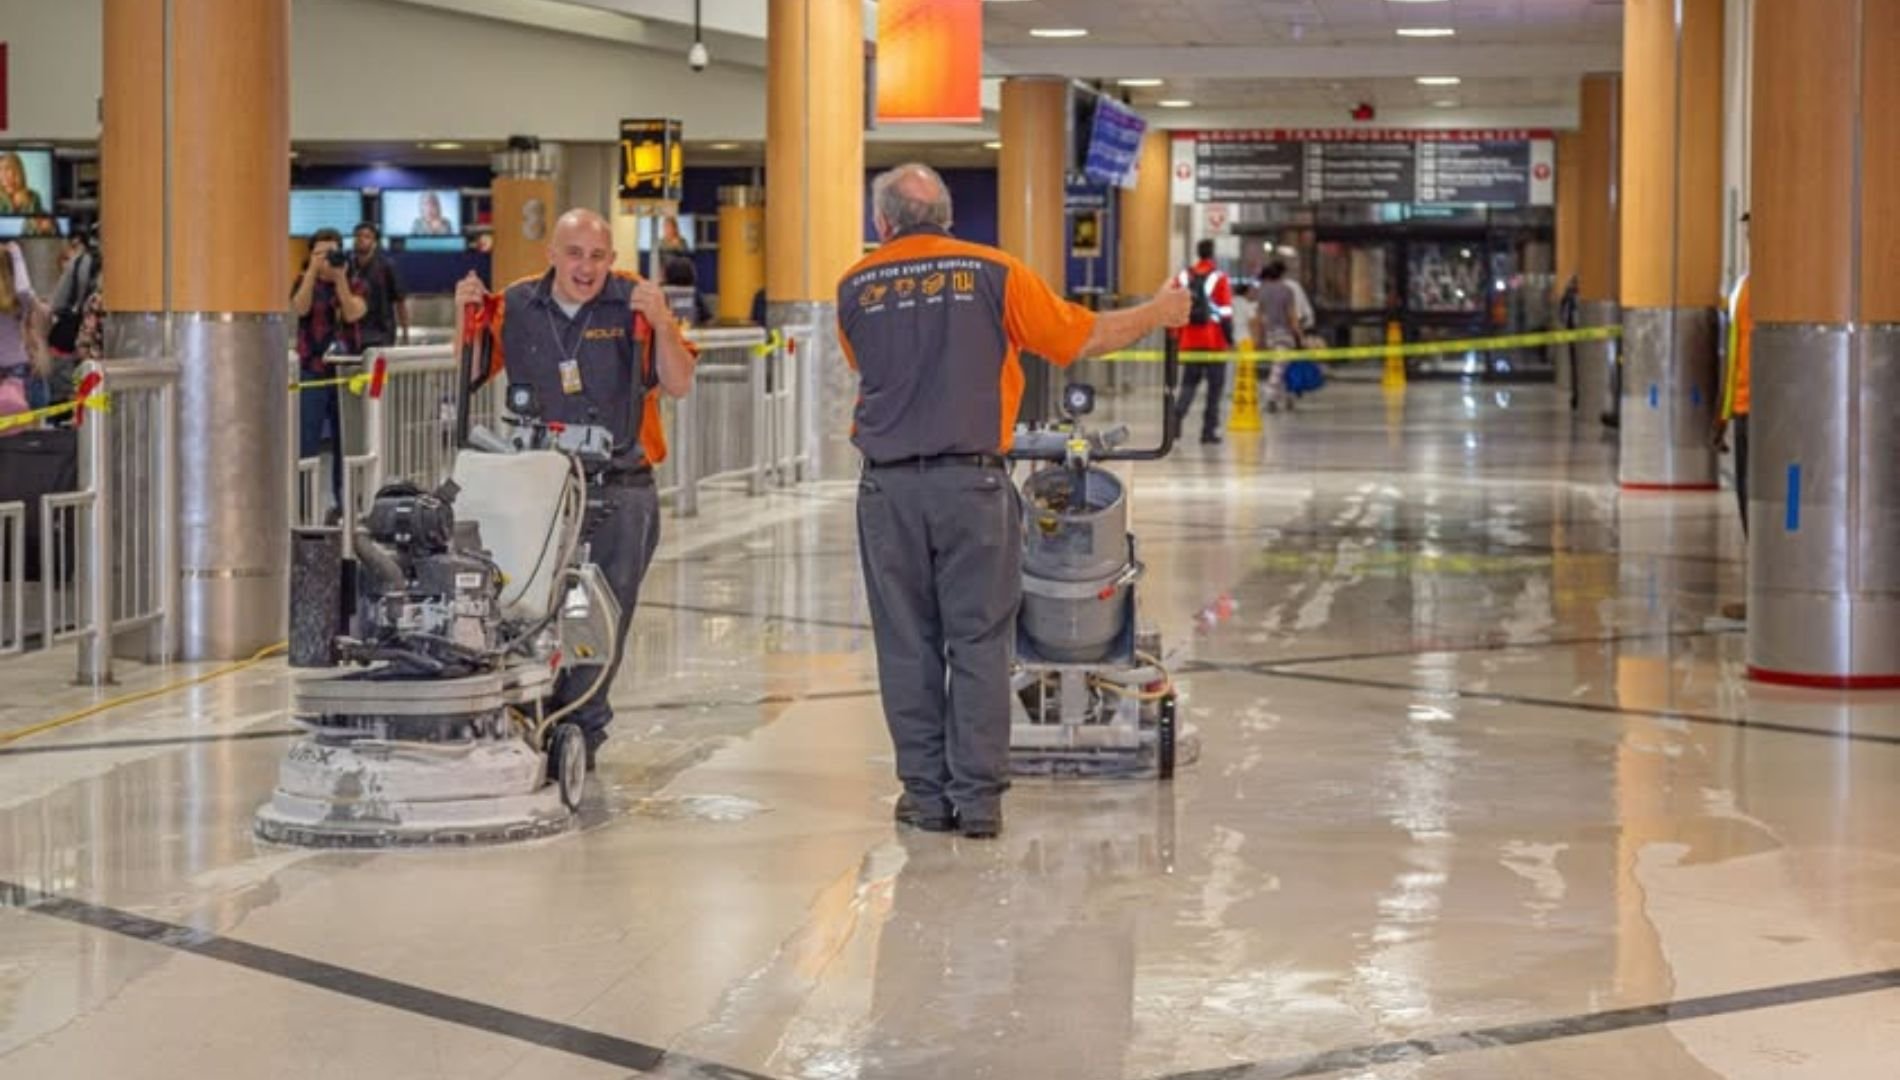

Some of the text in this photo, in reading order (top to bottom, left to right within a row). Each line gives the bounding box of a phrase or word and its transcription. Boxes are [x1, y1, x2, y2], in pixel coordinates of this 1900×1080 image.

[853, 259, 982, 286] CARE FOR EVERY SURFACE
